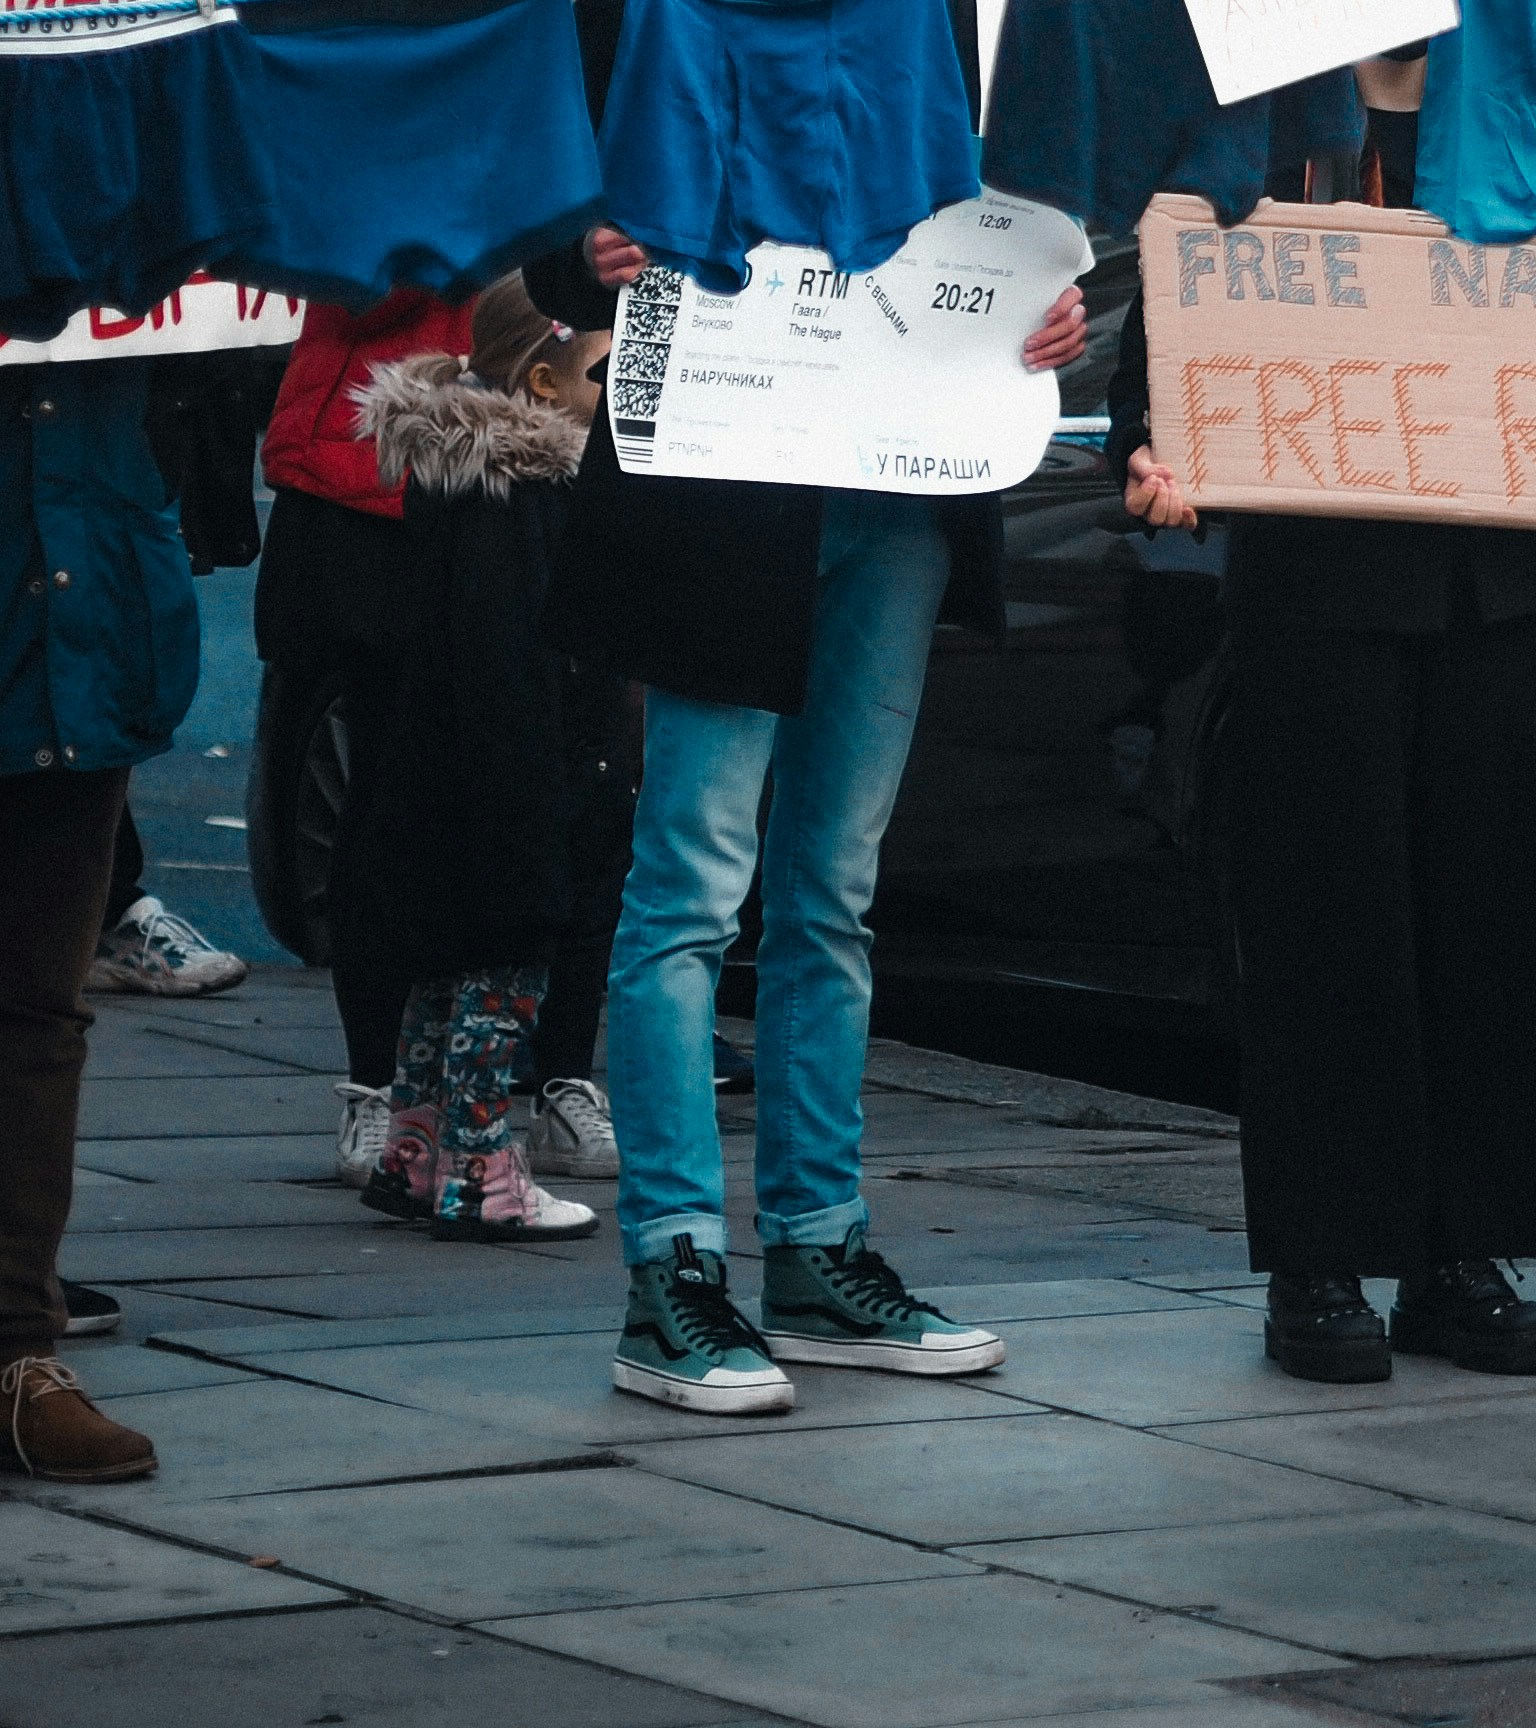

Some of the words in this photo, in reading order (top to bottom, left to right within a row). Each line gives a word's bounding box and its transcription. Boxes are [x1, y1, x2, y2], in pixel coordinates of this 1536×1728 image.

[978, 213, 1012, 231] 12:00
[797, 268, 850, 300] RTM
[1176, 228, 1368, 310] FREE
[872, 285, 910, 338] ВЕЩАМИ
[930, 281, 995, 315] 20:21
[788, 322, 808, 338] The
[808, 324, 842, 343] Hague
[679, 368, 689, 384] В
[690, 369, 774, 390] НАРУЧНИКАХ
[1180, 353, 1463, 498] FREE
[876, 453, 888, 476] У
[895, 454, 991, 480] ПАРАШИ
